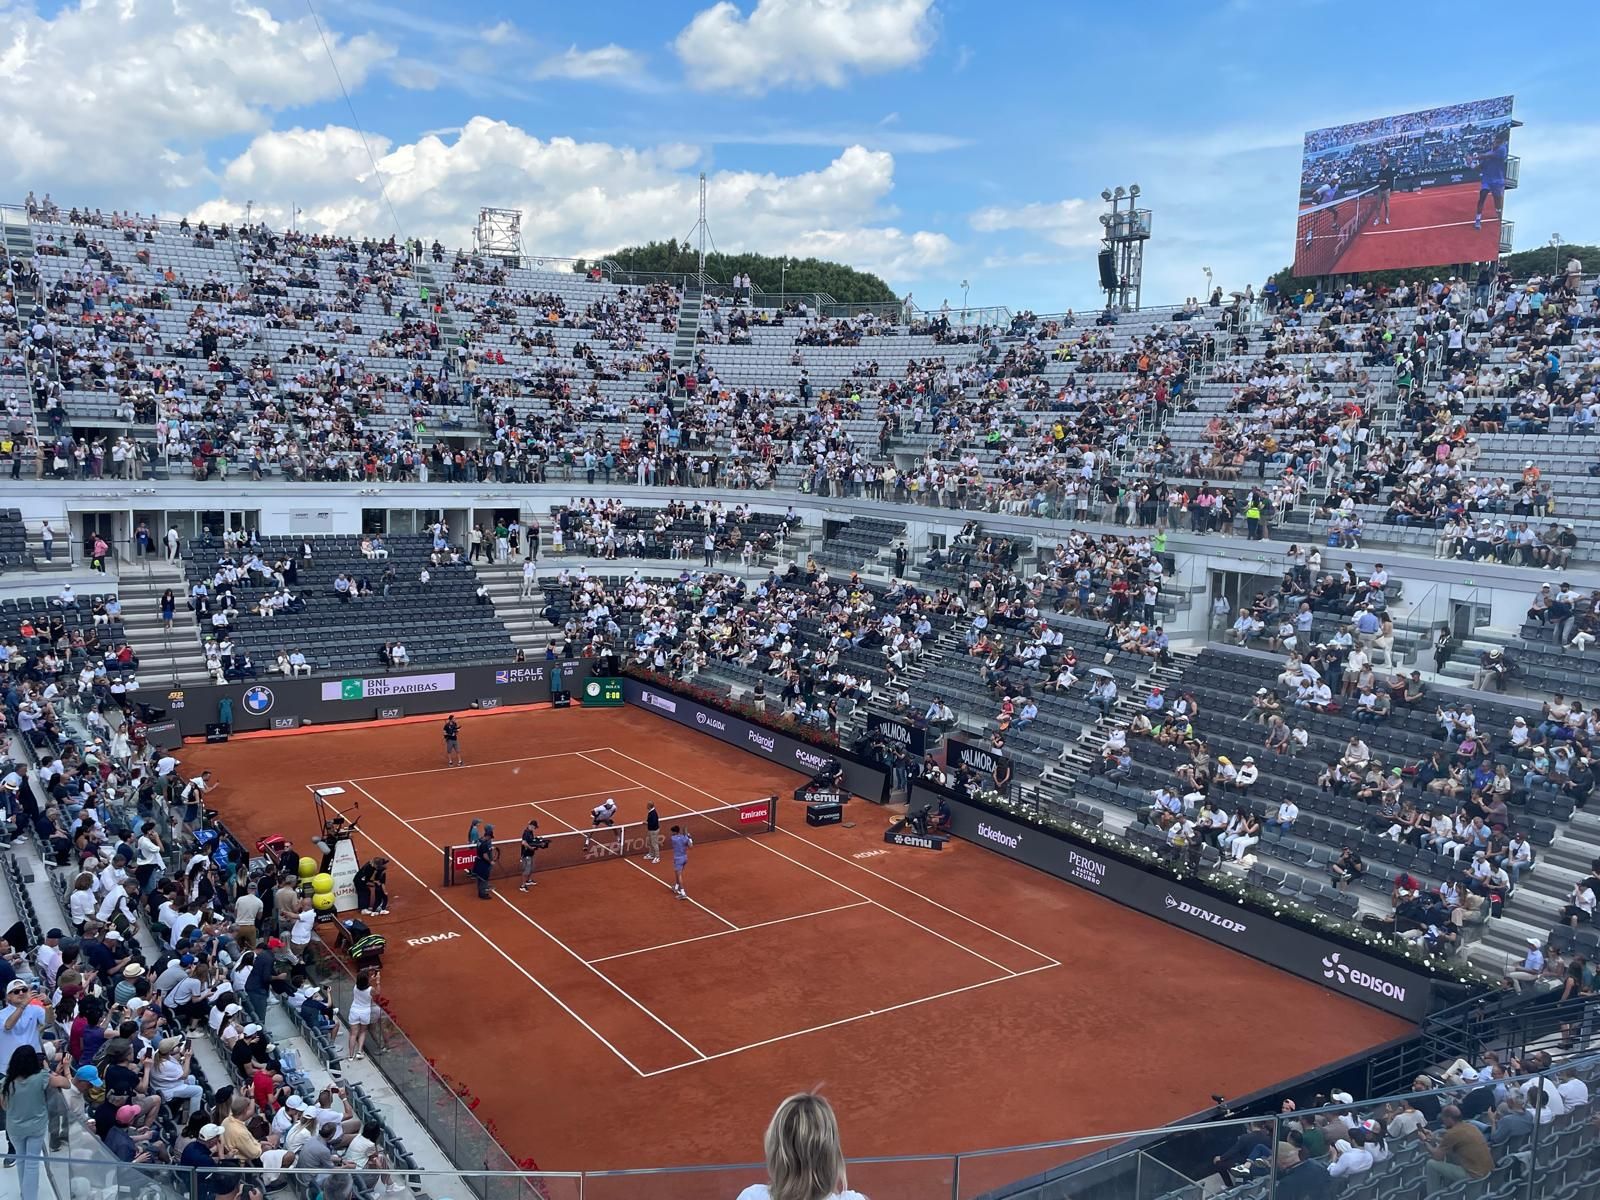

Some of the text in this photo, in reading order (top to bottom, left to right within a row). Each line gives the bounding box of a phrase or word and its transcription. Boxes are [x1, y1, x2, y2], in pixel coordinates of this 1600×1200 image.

[510, 667, 543, 677] REALE
[367, 679, 388, 687] BNL
[367, 683, 438, 696] BNP PARIBAS
[482, 699, 497, 707] EA7
[382, 709, 399, 717] EA7
[275, 719, 293, 728] EA7
[706, 718, 726, 731] ALGIDA
[748, 730, 775, 749] Polaroid
[880, 722, 912, 745] VALMORA
[961, 749, 998, 773] VALMORA
[813, 793, 840, 802] emu
[741, 810, 768, 820] Emirates
[978, 822, 1018, 849] ticketone
[903, 836, 932, 848] emu
[457, 854, 478, 865] Emir
[852, 849, 891, 859] ROMA
[1069, 851, 1106, 876] PERONI
[1071, 870, 1101, 885] AZZURRO
[1076, 866, 1097, 878] NASTRO
[1177, 901, 1247, 933] DUNLOP
[407, 931, 461, 947] ROMA
